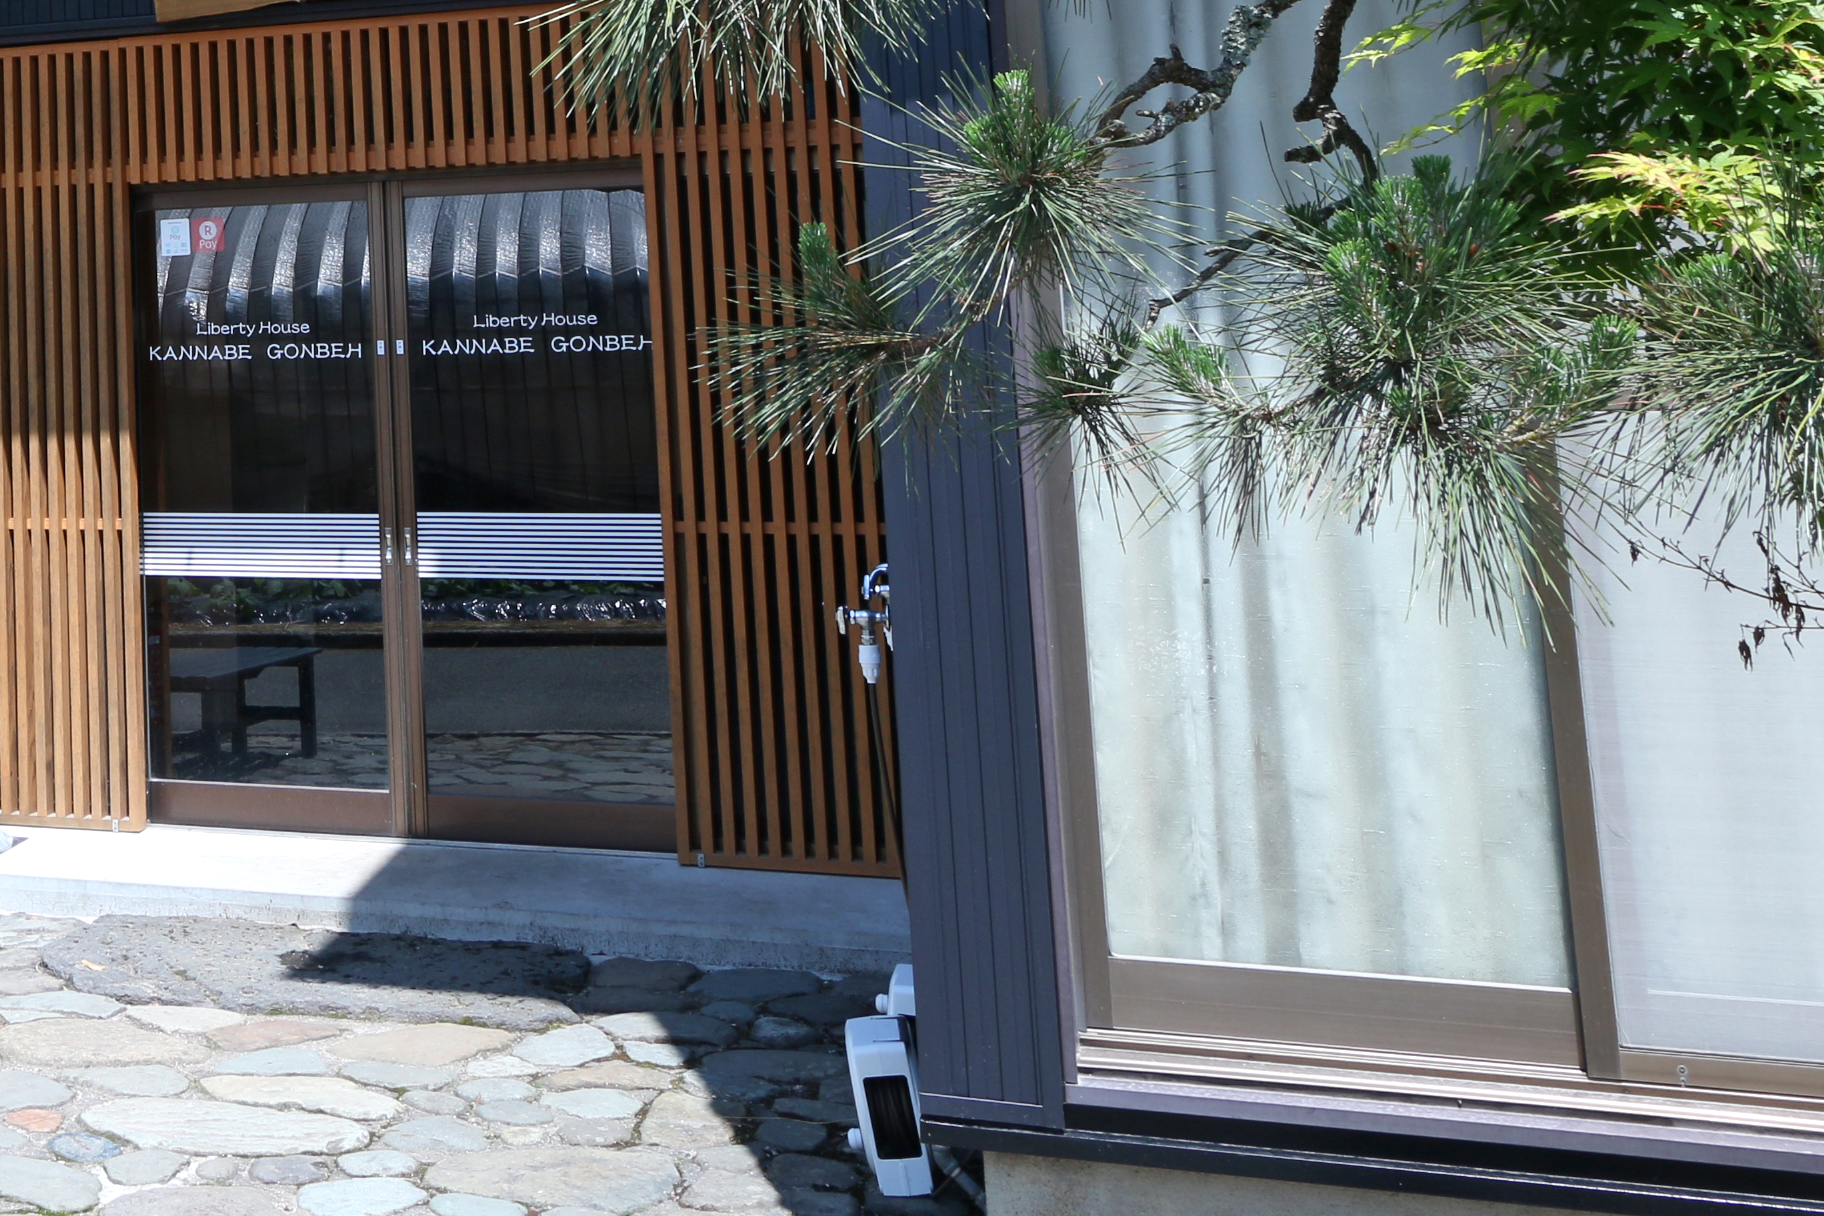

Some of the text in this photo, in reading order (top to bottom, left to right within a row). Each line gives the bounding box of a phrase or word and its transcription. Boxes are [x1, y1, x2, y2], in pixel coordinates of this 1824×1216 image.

[199, 239, 218, 250] Pay
[196, 321, 310, 337] Liberty House
[473, 312, 598, 330] Liberty House
[149, 344, 253, 361] KANNABE
[266, 342, 363, 360] GONBEH
[422, 337, 535, 356] KANNABE
